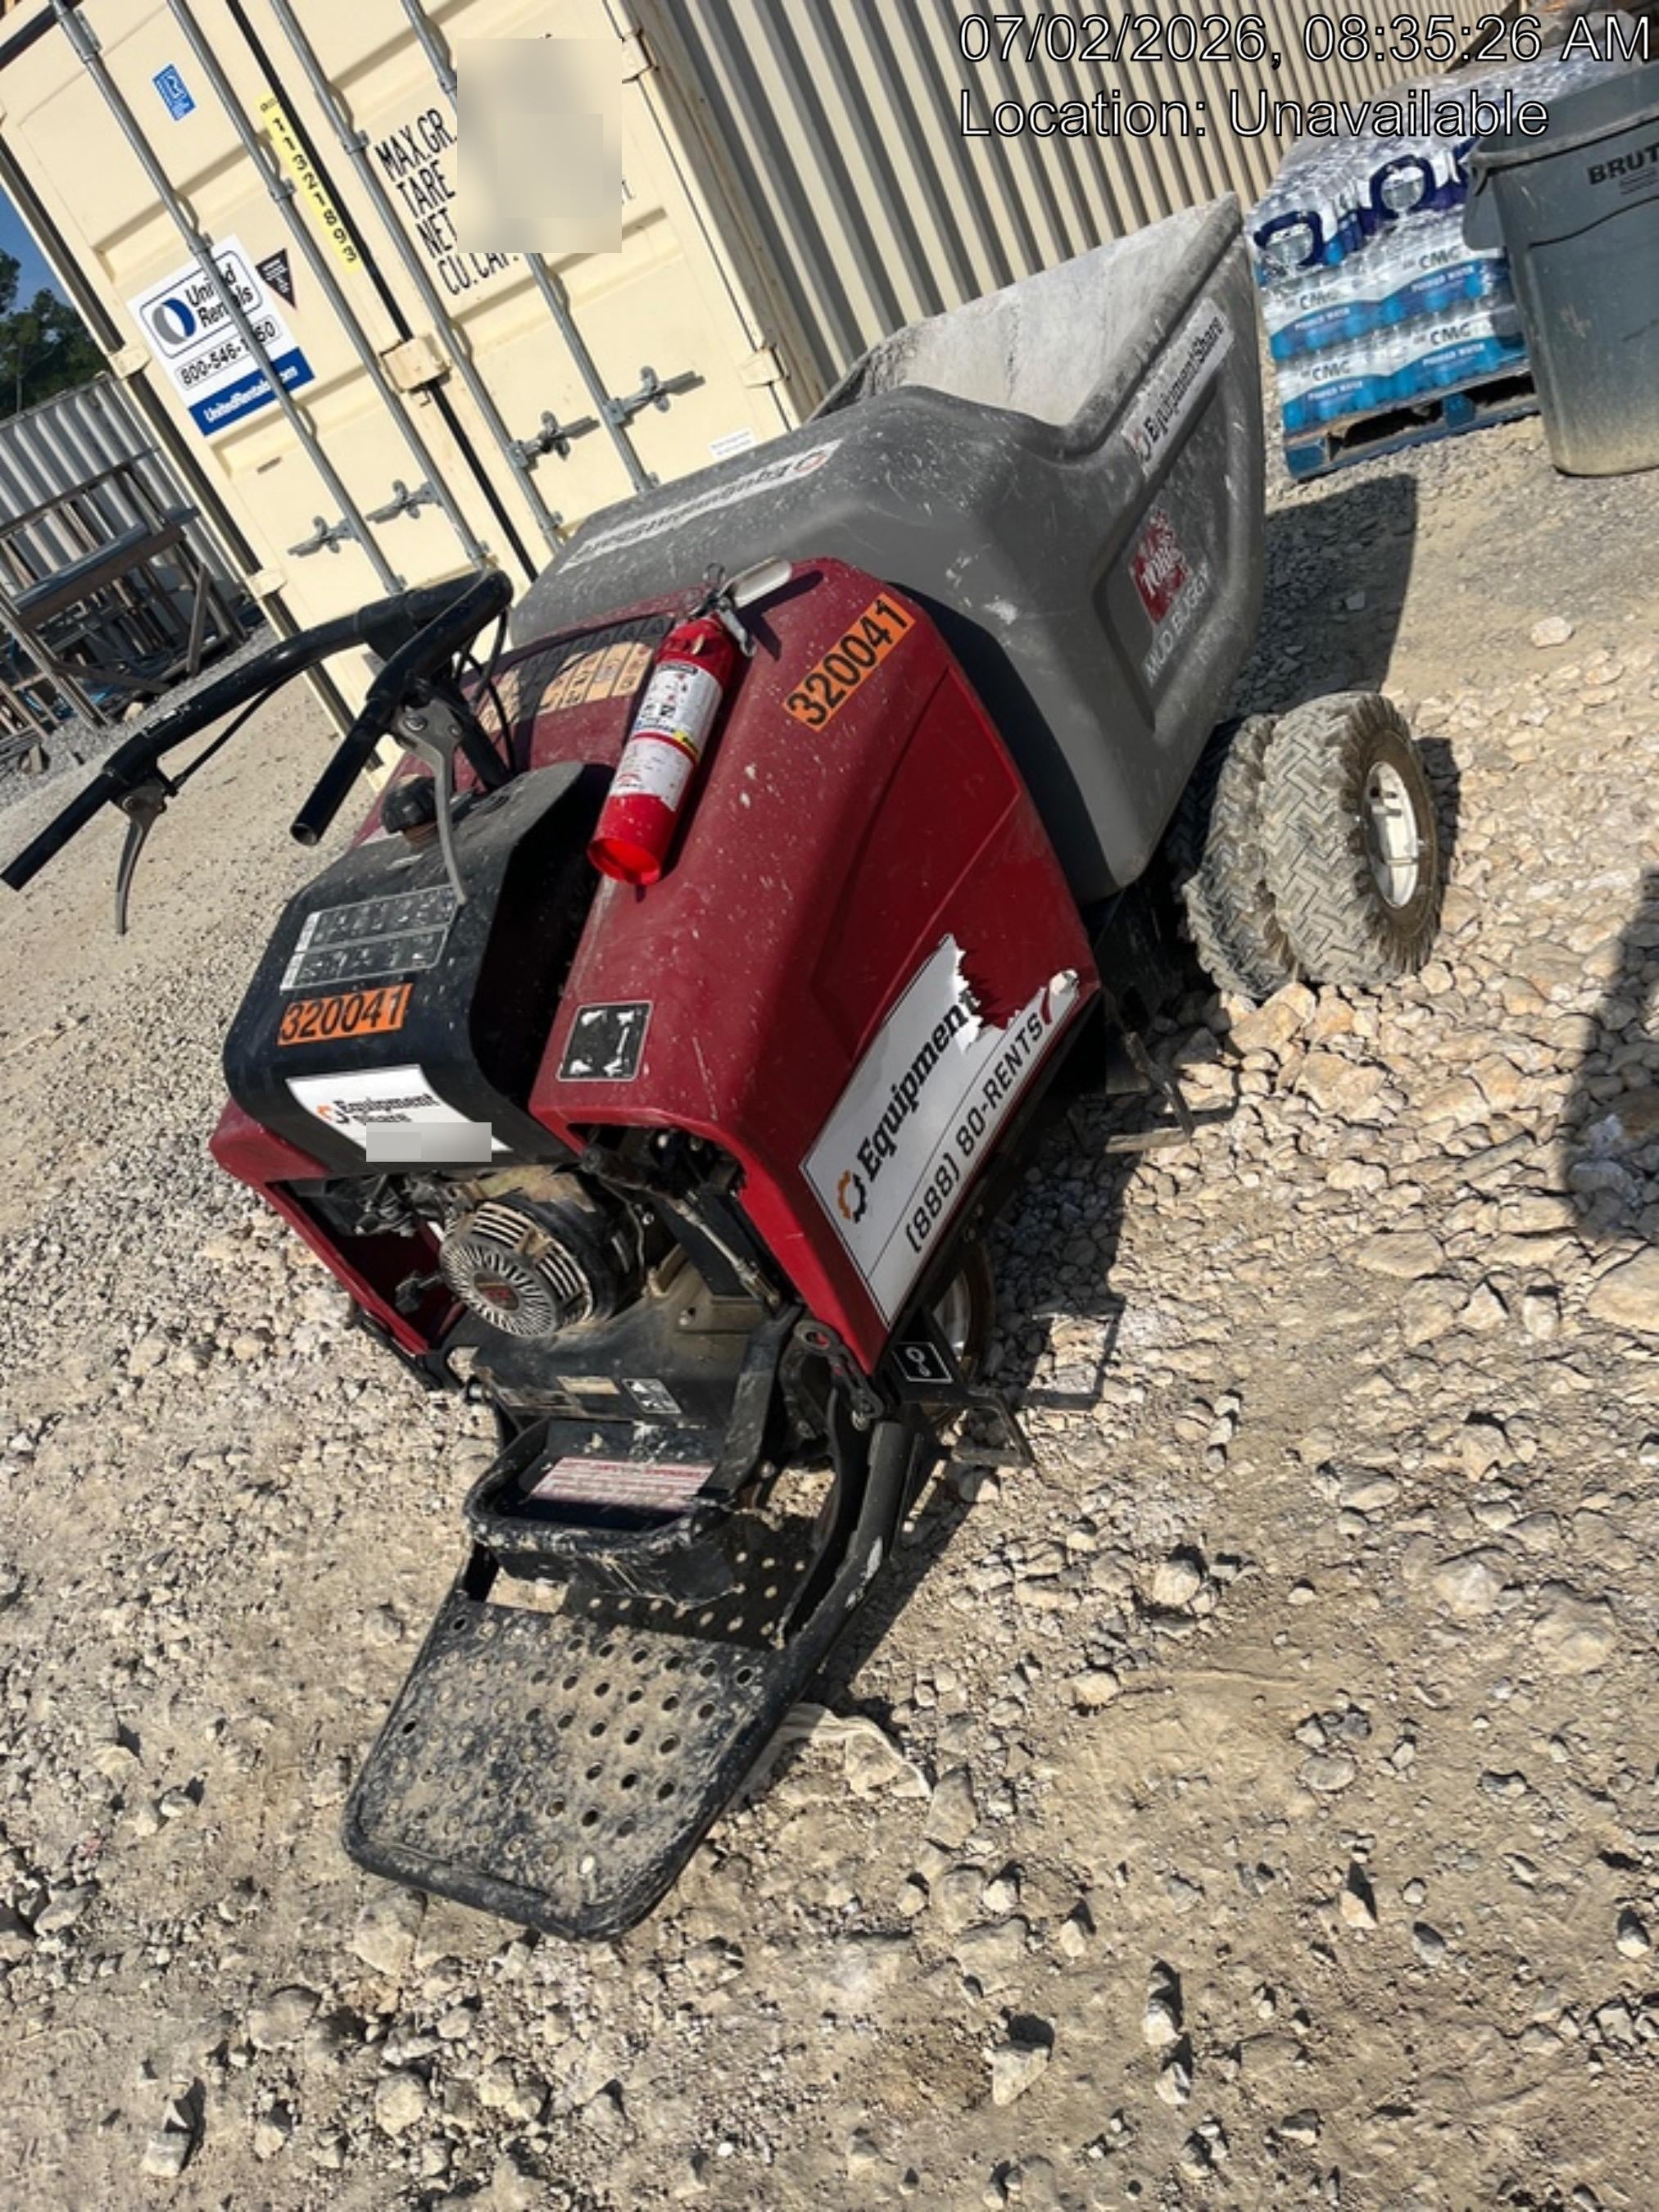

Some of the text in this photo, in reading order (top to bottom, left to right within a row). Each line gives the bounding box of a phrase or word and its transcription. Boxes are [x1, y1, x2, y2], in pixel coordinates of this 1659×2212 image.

[396, 160, 456, 220] TARE
[184, 263, 238, 308] Unid
[786, 599, 908, 726] 320041
[280, 985, 404, 1040] 320041
[858, 988, 981, 1183] Equipment
[905, 1012, 1044, 1254] (888) 80-RENTS
